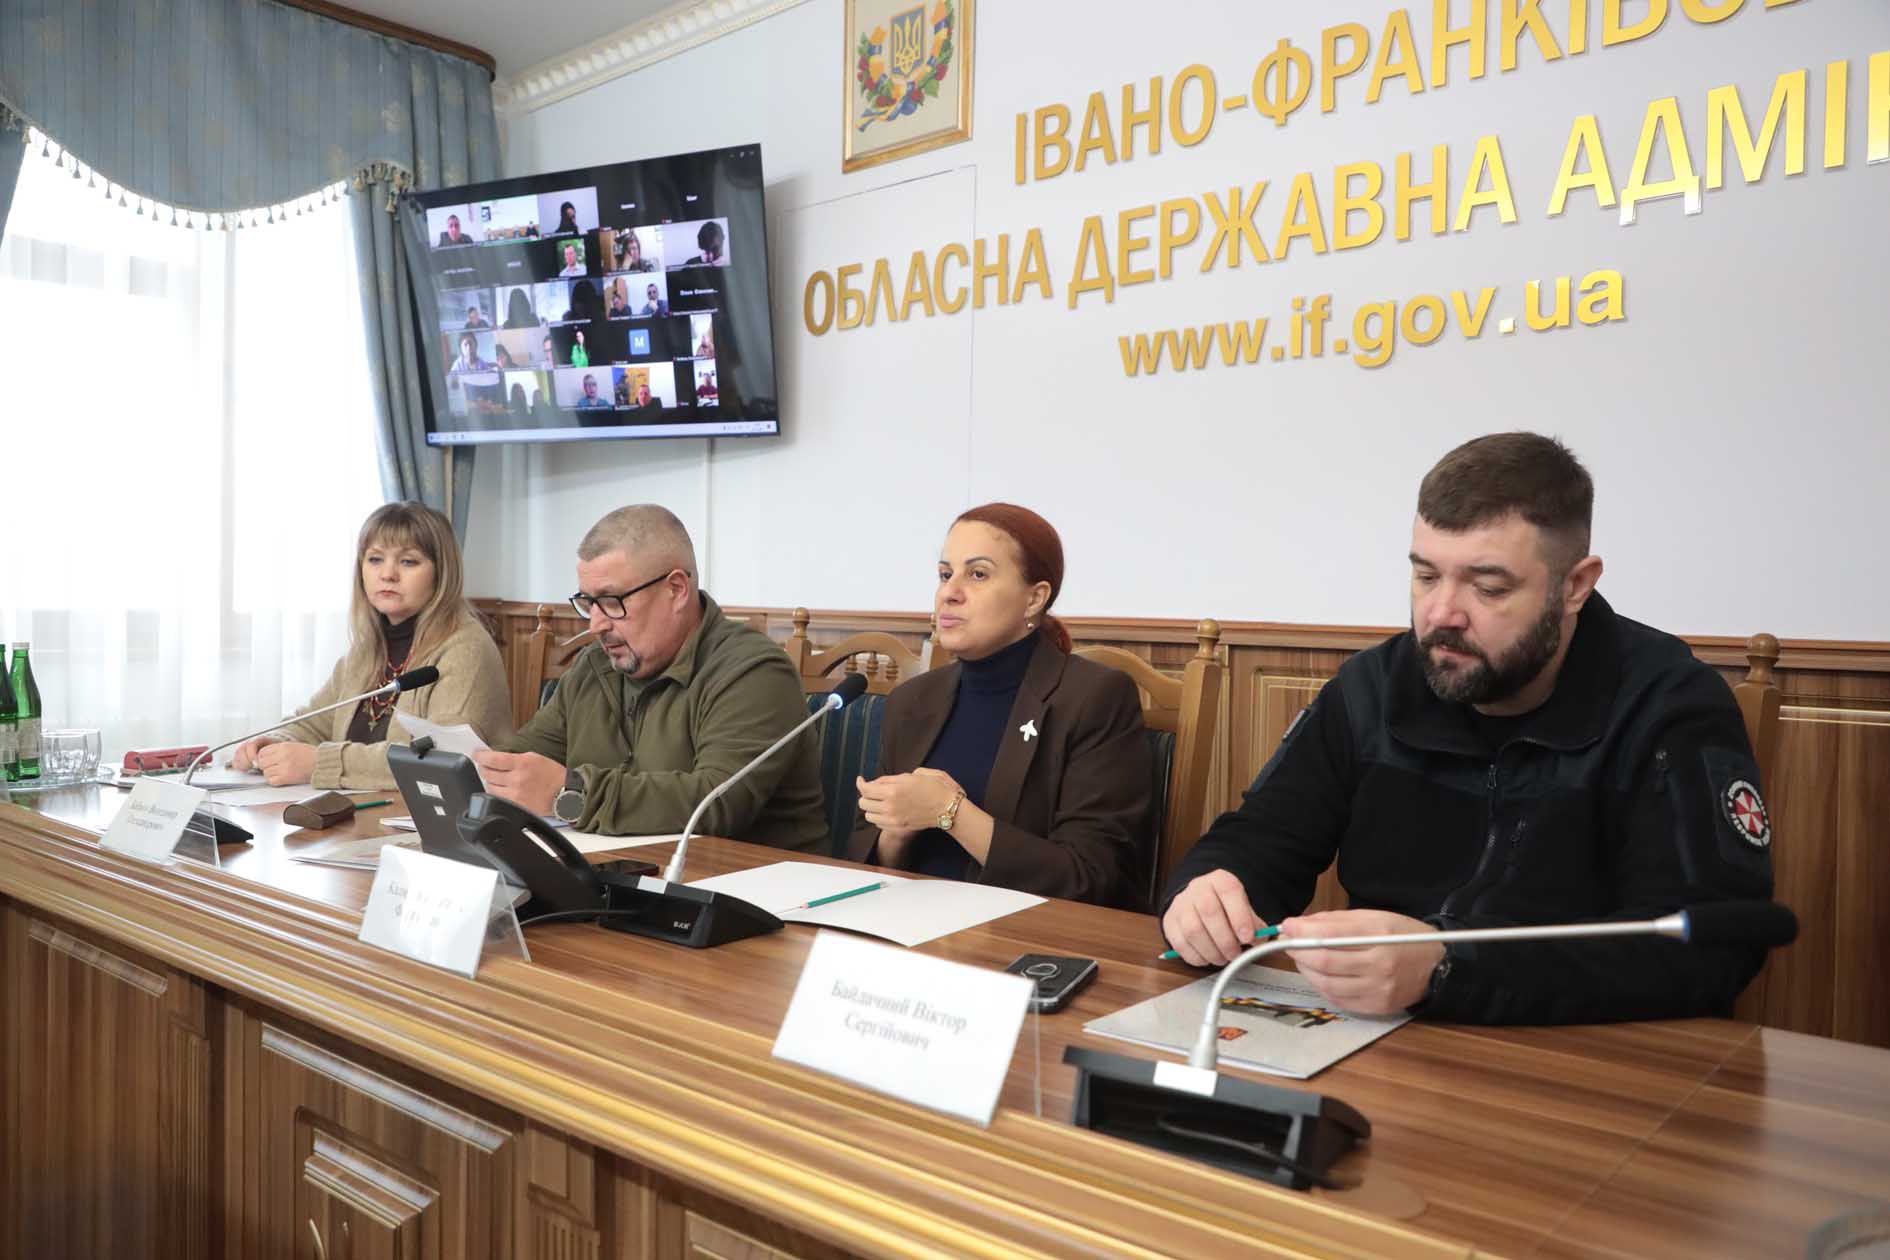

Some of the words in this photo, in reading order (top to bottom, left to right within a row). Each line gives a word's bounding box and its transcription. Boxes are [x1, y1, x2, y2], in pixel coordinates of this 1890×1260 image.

[1015, 0, 1811, 185] ІВАНО-ФРАНКІ
[803, 227, 1053, 337] ОБЛАСНА
[1068, 135, 1518, 309] ДЕРЖАВНА
[1119, 267, 1626, 377] www.if.gov.ua
[912, 1001, 967, 1034] Віктор
